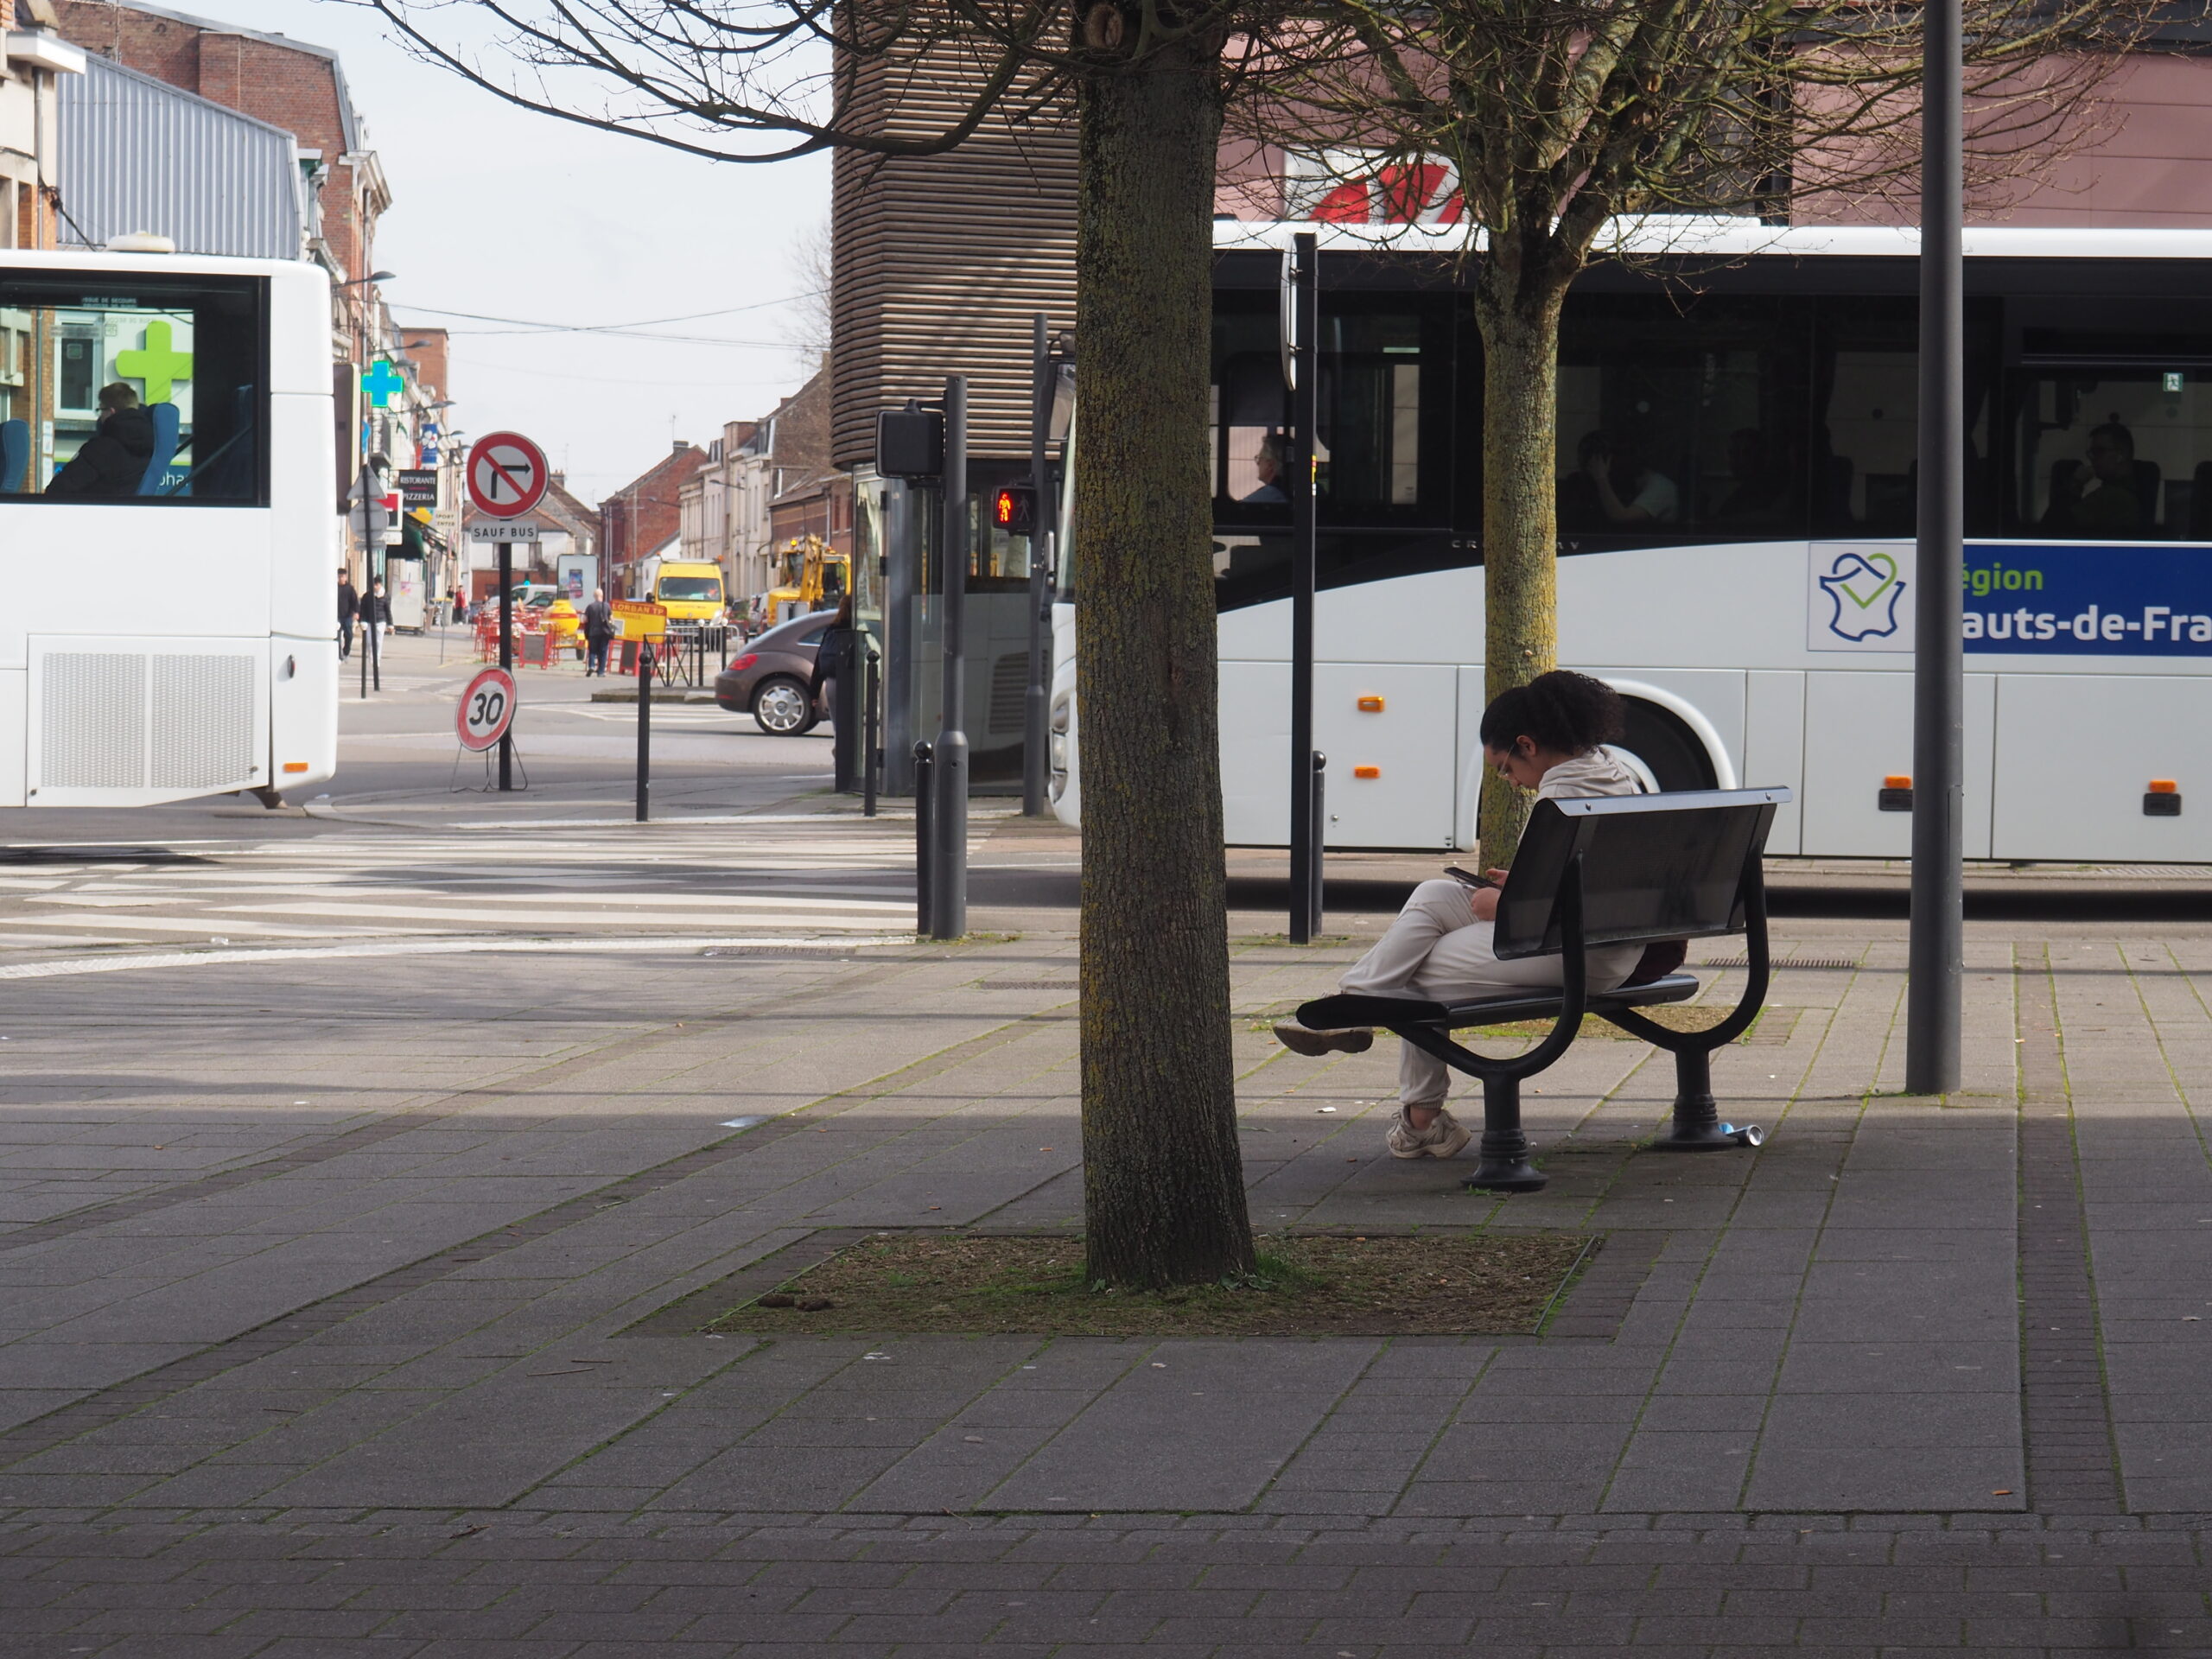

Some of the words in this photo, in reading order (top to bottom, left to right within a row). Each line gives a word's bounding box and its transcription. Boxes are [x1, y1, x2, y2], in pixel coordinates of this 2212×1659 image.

[400, 476, 436, 485] RISTORANTE
[474, 527, 505, 537] SAUF
[511, 527, 535, 537] BUS
[612, 603, 650, 613] LORBAN
[1962, 604, 2212, 642] auts-de-Fra
[469, 692, 504, 726] 30
